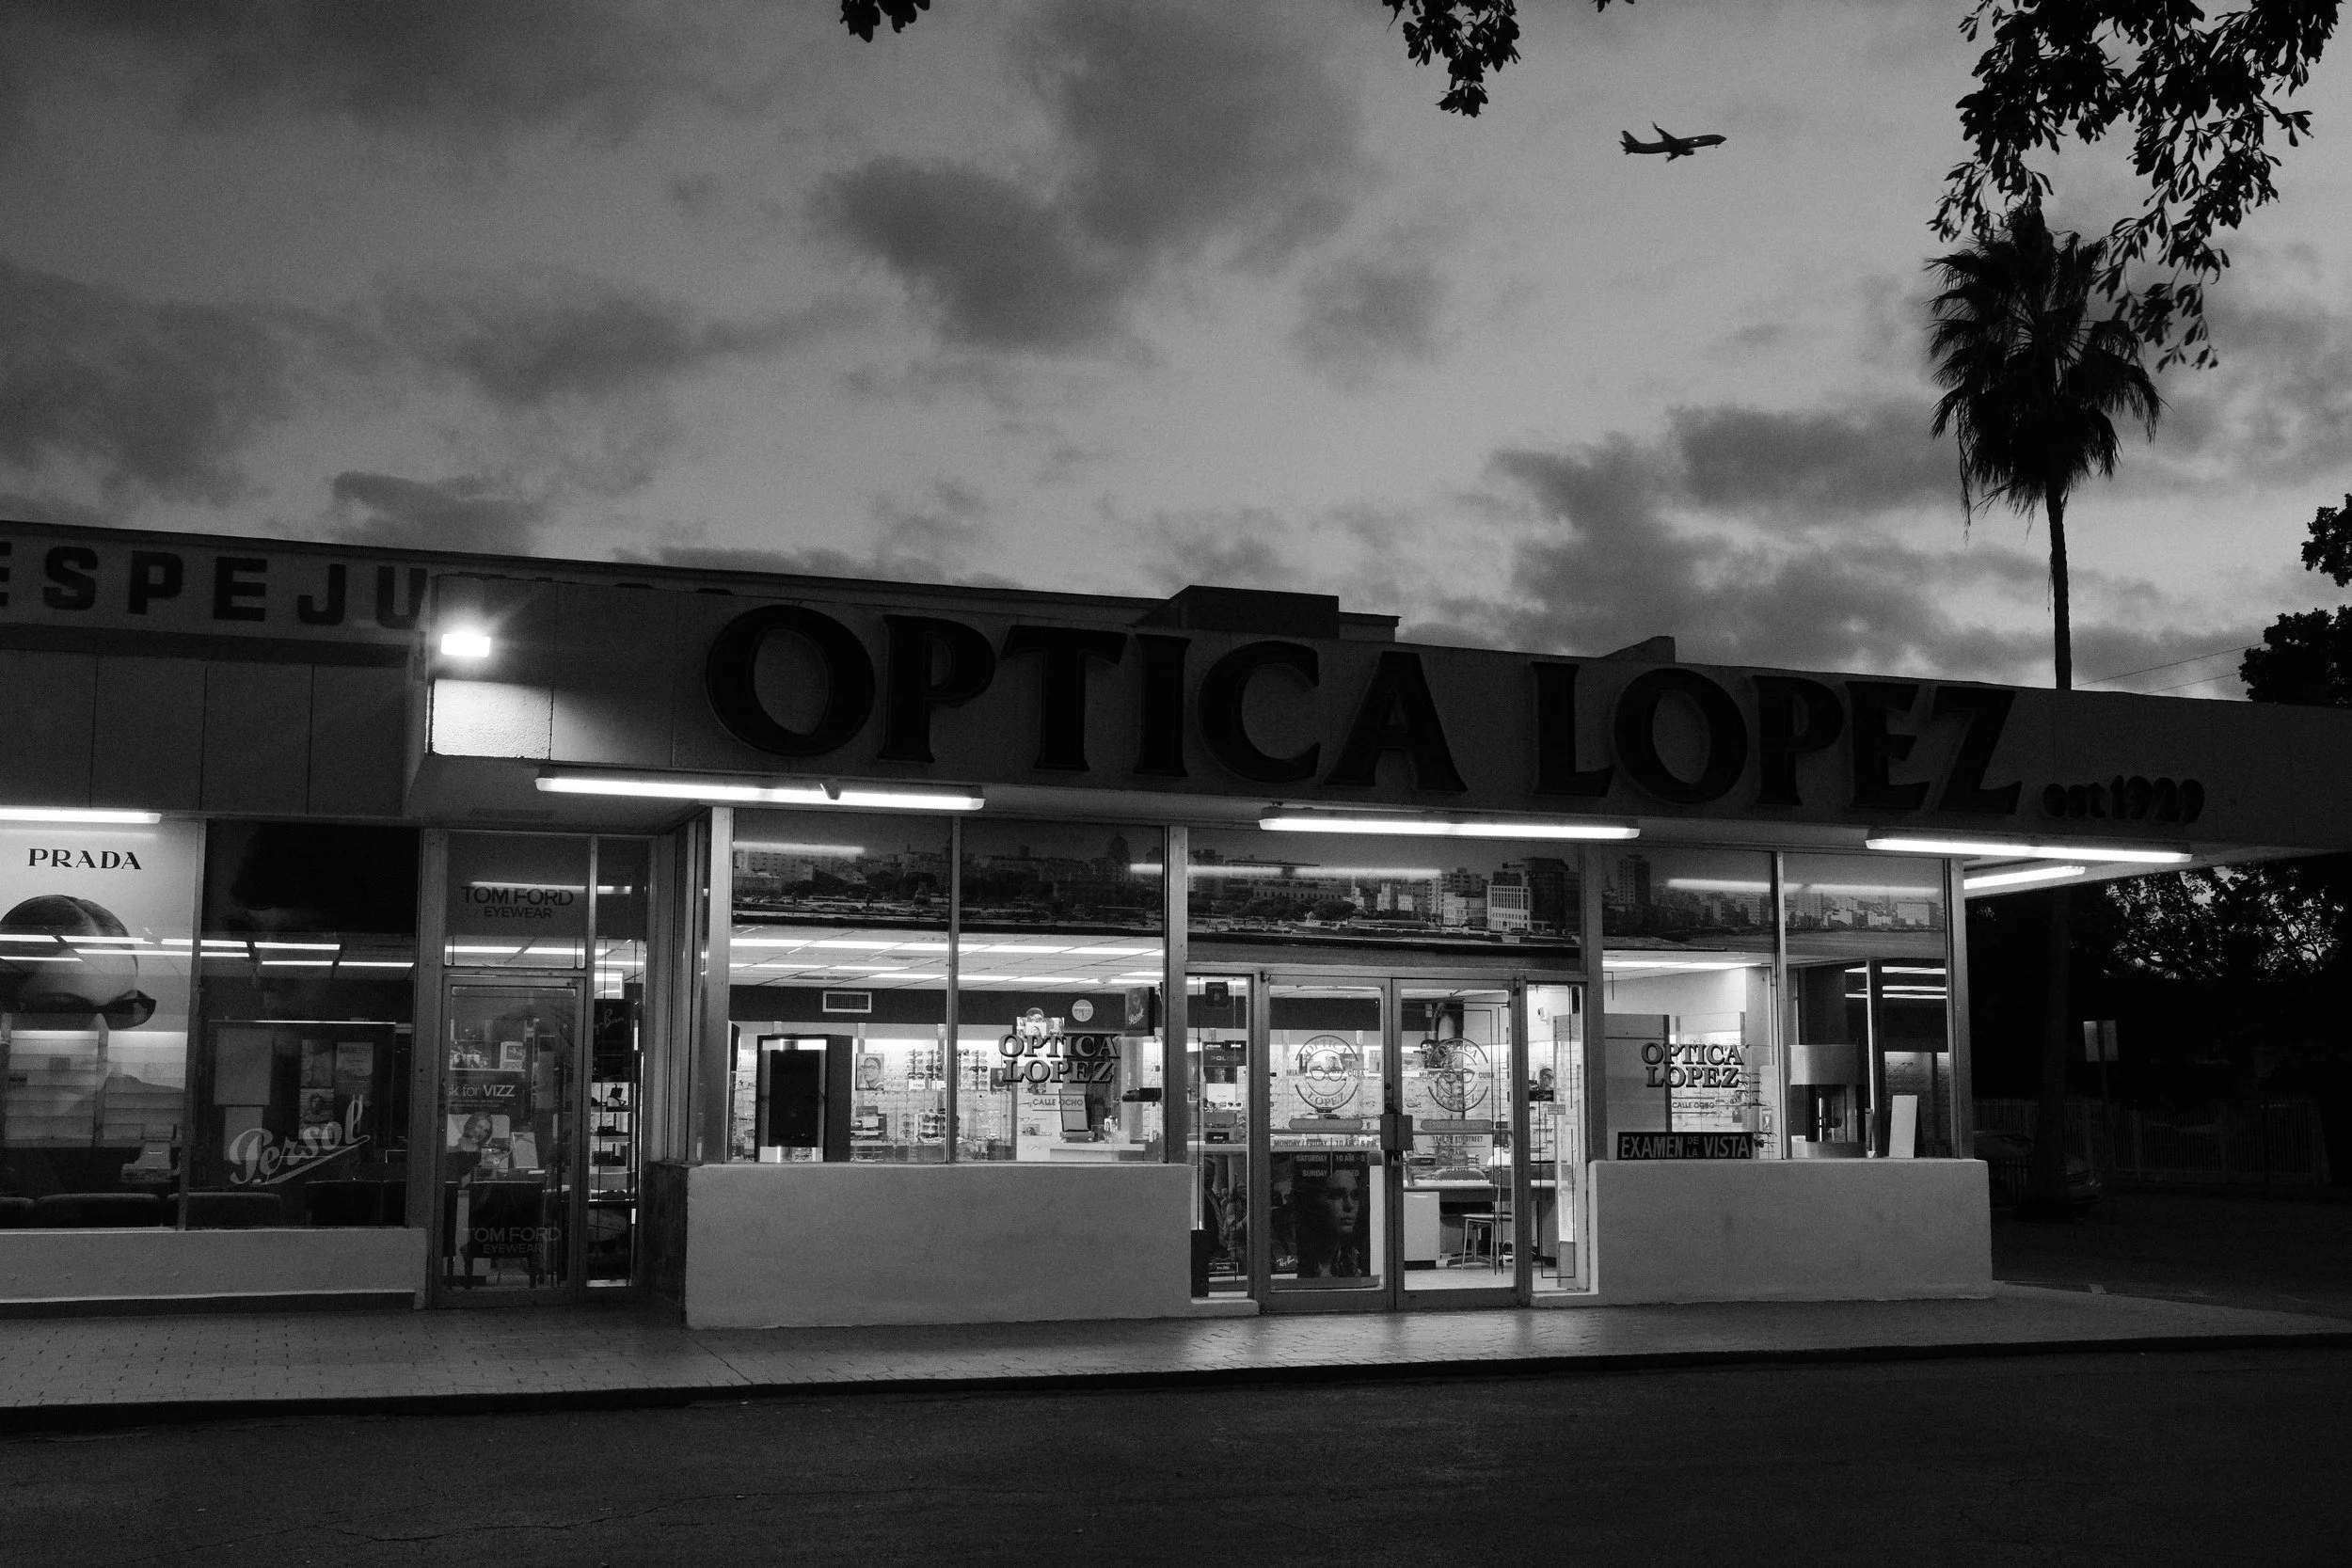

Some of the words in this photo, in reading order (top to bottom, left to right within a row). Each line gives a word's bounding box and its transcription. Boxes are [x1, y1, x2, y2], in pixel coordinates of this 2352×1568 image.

[0, 542, 428, 629] SPEJU
[706, 604, 1468, 793] OPTICA
[1534, 662, 2023, 816] LOPEZ
[2110, 774, 2205, 823] 1929
[28, 847, 142, 870] PRADA
[461, 886, 509, 904] TOM
[514, 888, 574, 905] FORD
[484, 906, 552, 918] EYEWEAR
[998, 1034, 1120, 1059] OPTICA
[1641, 1042, 1745, 1065] OPTICA
[1003, 1059, 1114, 1084] LOPEZ
[1347, 1069, 1365, 1077] CUBA
[1645, 1067, 1740, 1088] LOPEZ
[462, 1084, 480, 1097] for
[483, 1084, 516, 1098] VIZZ
[1307, 1091, 1347, 1107] LOPEZ
[1032, 1098, 1057, 1106] CALLE
[1058, 1098, 1083, 1107] OCHO
[229, 1094, 371, 1185] Persol
[1273, 1139, 1300, 1148] MONDAY
[1336, 1139, 1343, 1148] 10
[1620, 1135, 1684, 1159] EXAMEN
[1687, 1136, 1699, 1145] DE
[1703, 1135, 1751, 1159] VISTA
[1295, 1154, 1328, 1163] SATURDAY
[1686, 1148, 1698, 1158] LA
[463, 1227, 505, 1243] TOM
[509, 1227, 562, 1243] FORD
[482, 1243, 544, 1254] EYEWEAR
